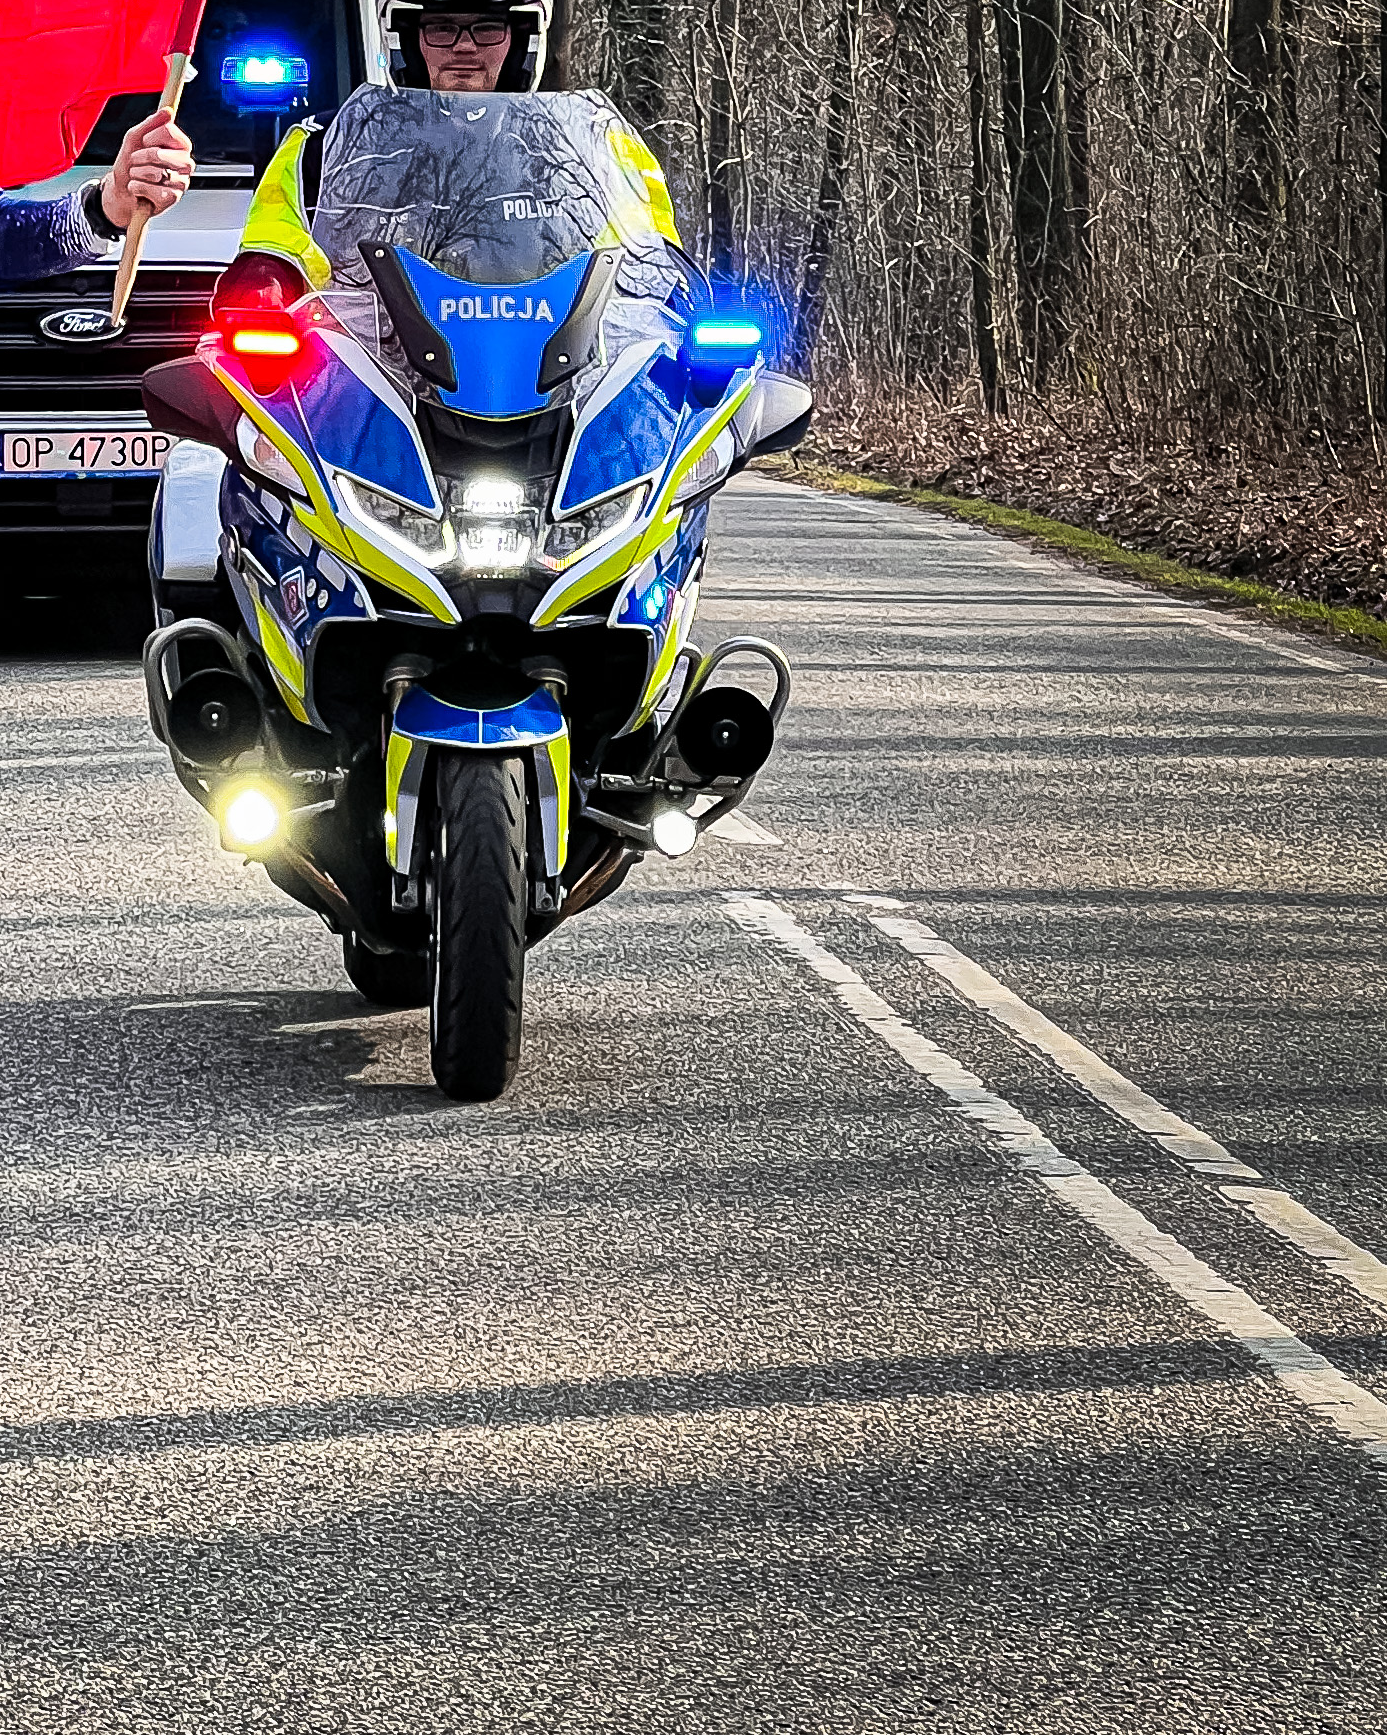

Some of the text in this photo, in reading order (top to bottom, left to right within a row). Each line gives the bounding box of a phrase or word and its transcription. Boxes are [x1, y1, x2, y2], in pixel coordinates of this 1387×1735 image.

[59, 313, 106, 333] Ford
[440, 296, 555, 323] POLICJA
[12, 436, 171, 468] OP 4730P
